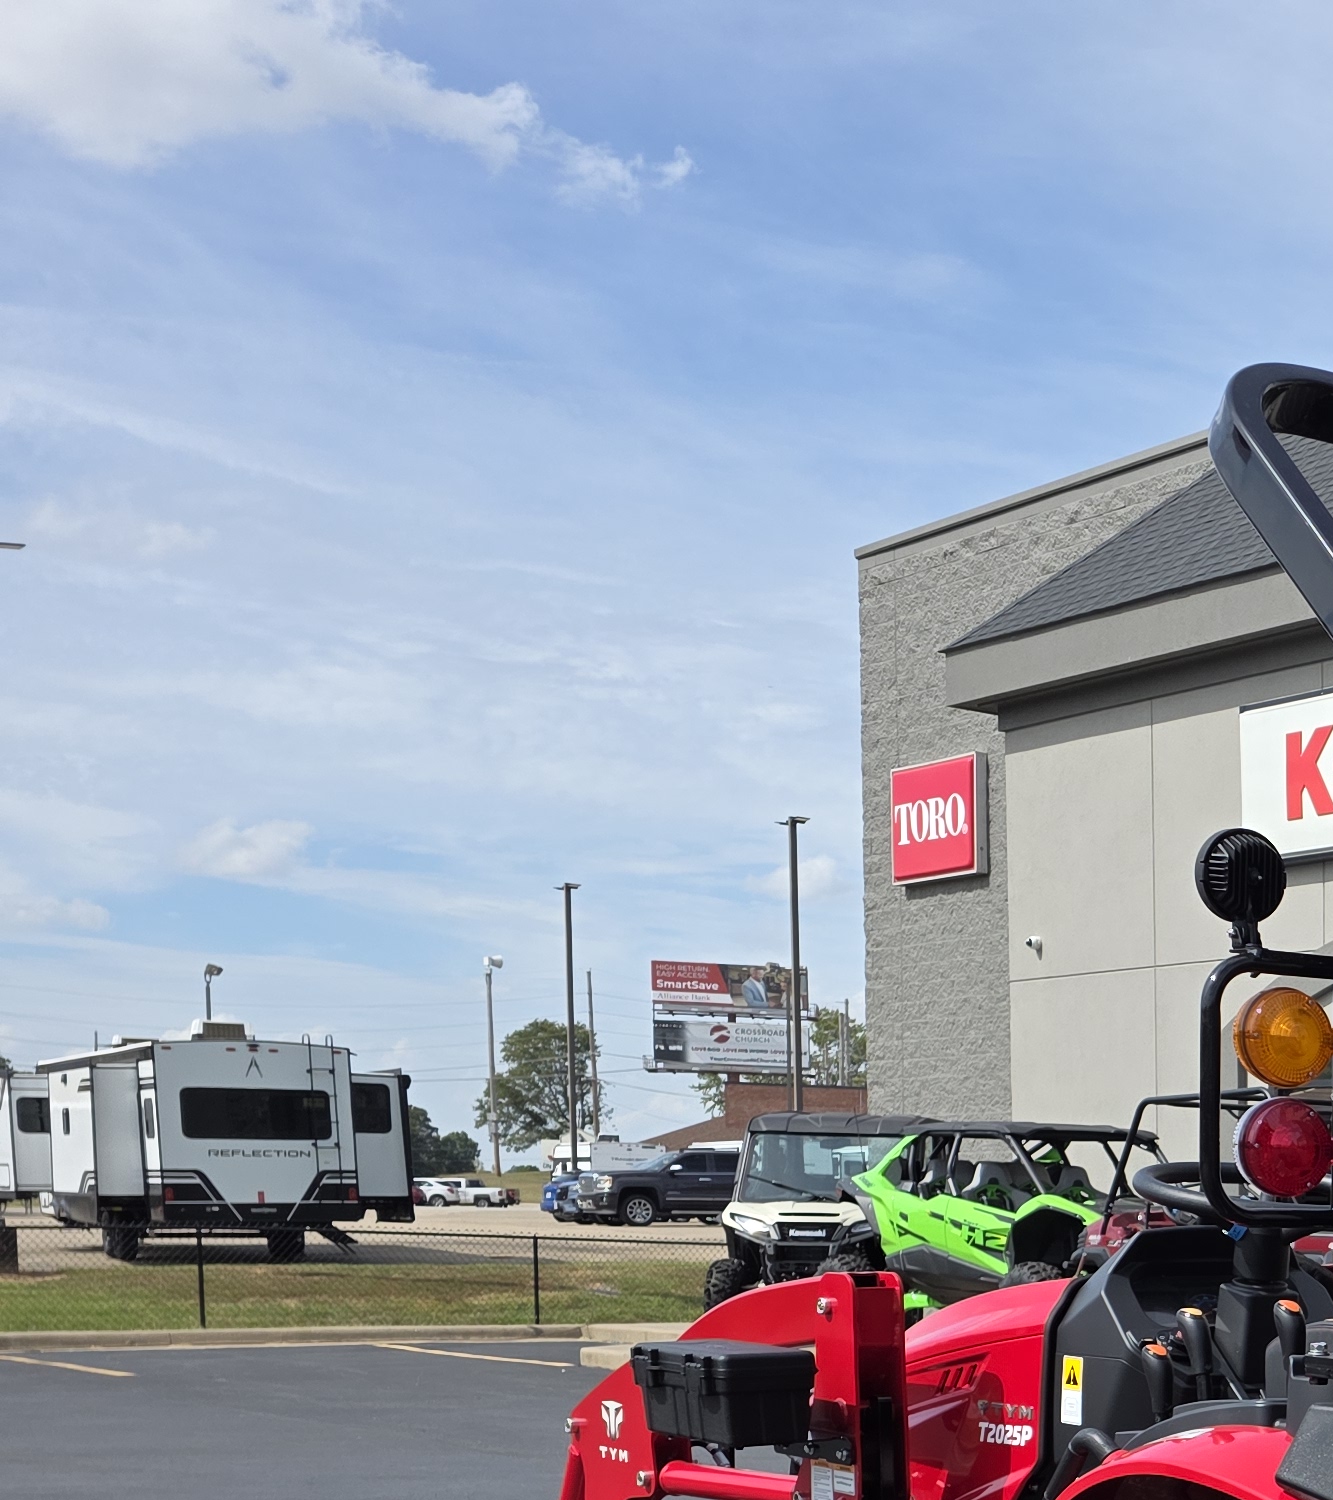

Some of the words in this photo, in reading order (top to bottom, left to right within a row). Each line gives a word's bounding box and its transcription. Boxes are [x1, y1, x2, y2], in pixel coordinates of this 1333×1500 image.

[894, 792, 967, 846] TORO
[655, 963, 676, 971] HIGH
[656, 970, 676, 978] EASY
[656, 979, 719, 990] SmartSave
[657, 992, 690, 1000] Alliance
[735, 1028, 788, 1037] CROSSROAD
[735, 1036, 771, 1044] CHURCH
[207, 1148, 312, 1158] REFLECTION
[990, 1401, 1035, 1420] TYM
[978, 1421, 1034, 1447] T2025P
[598, 1445, 629, 1464] TYM
